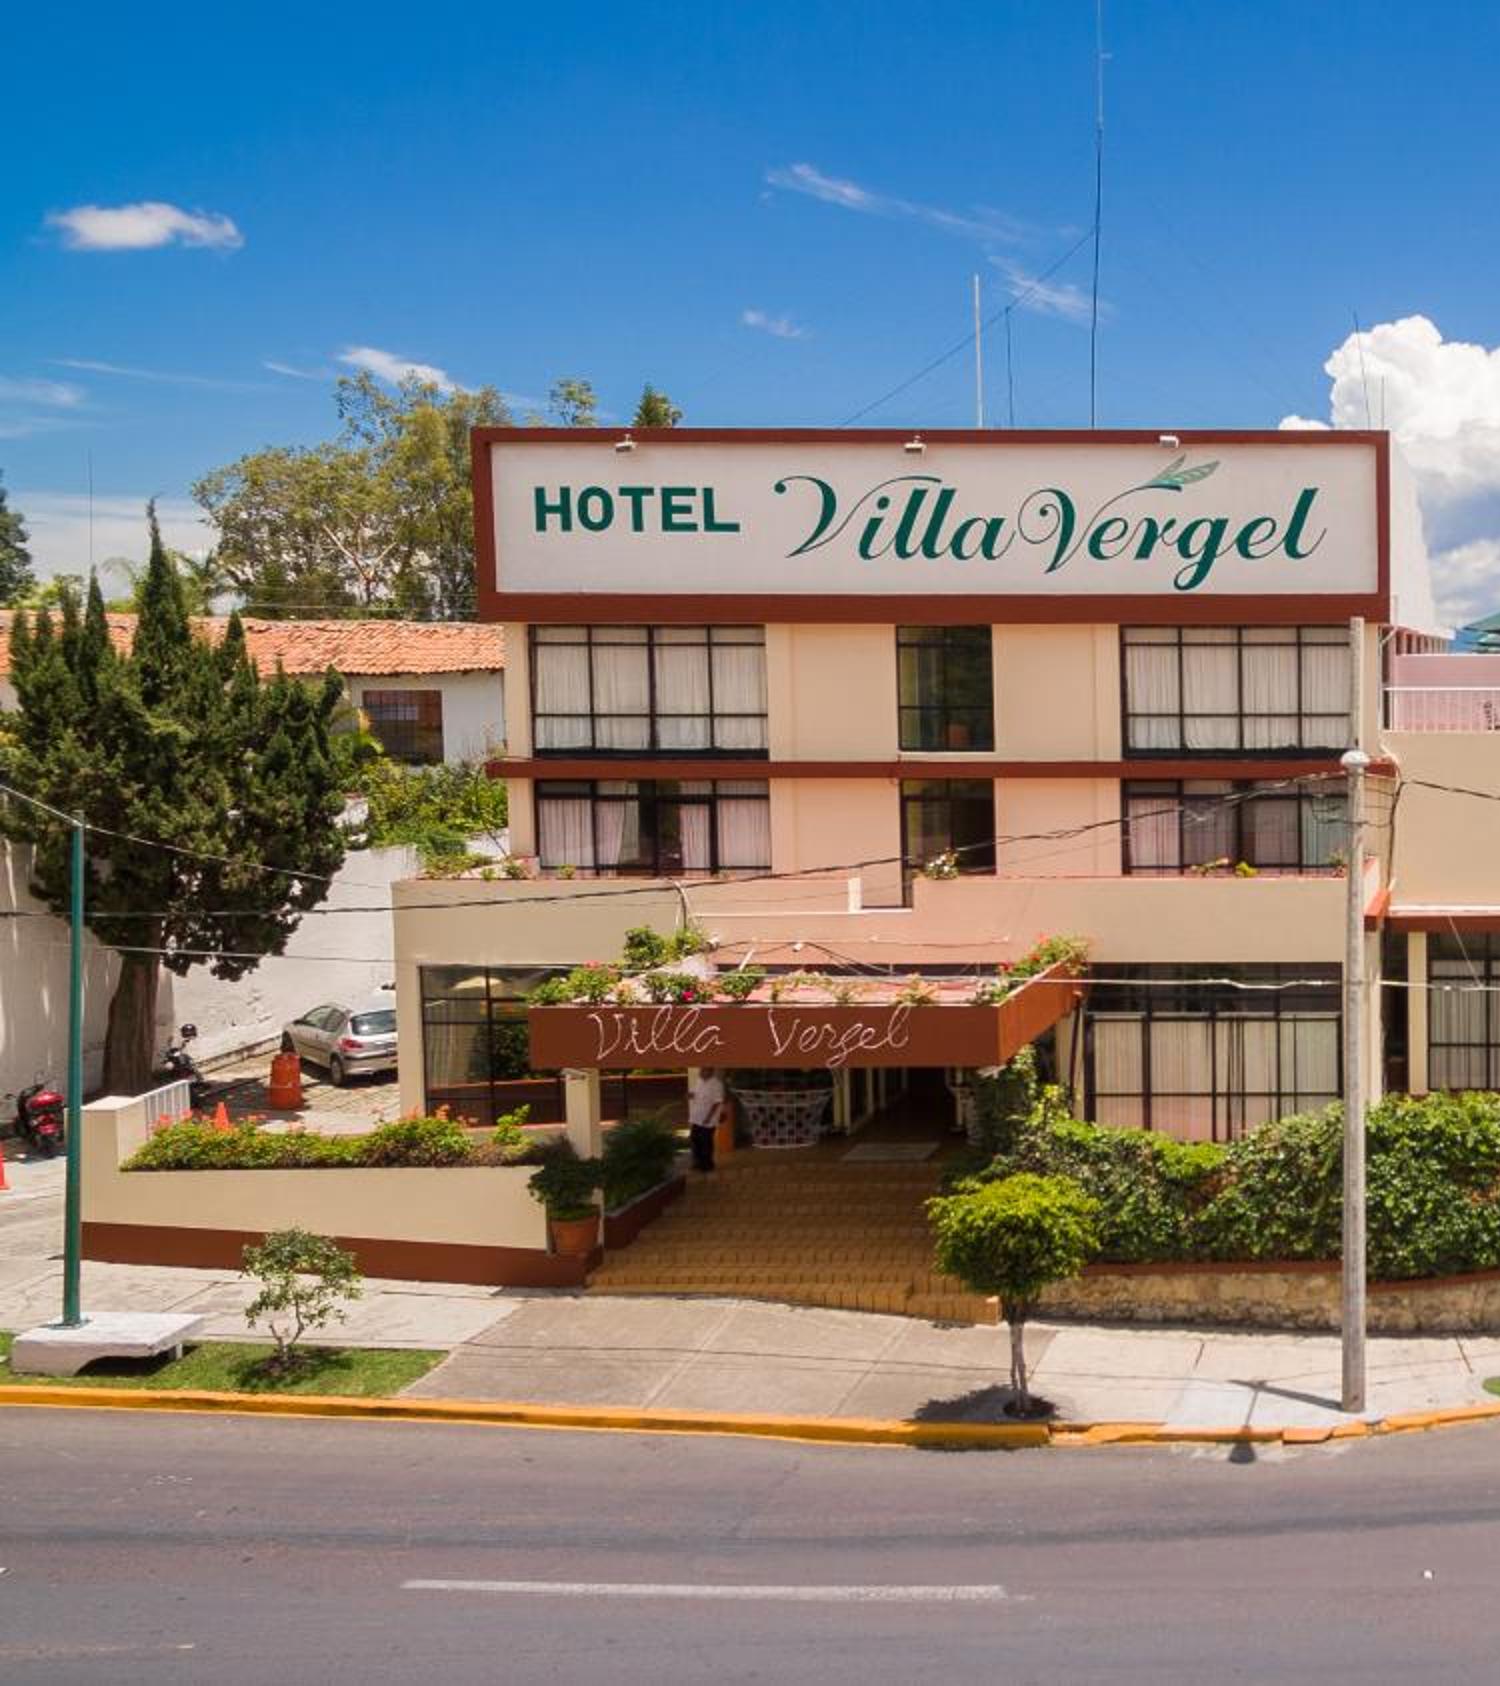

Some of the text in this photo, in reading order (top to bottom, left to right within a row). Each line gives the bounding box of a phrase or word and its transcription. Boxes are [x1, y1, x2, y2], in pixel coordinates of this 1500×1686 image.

[534, 475, 1325, 591] HOTEL Villa Vergel
[588, 1002, 910, 1068] Villa Vergel
